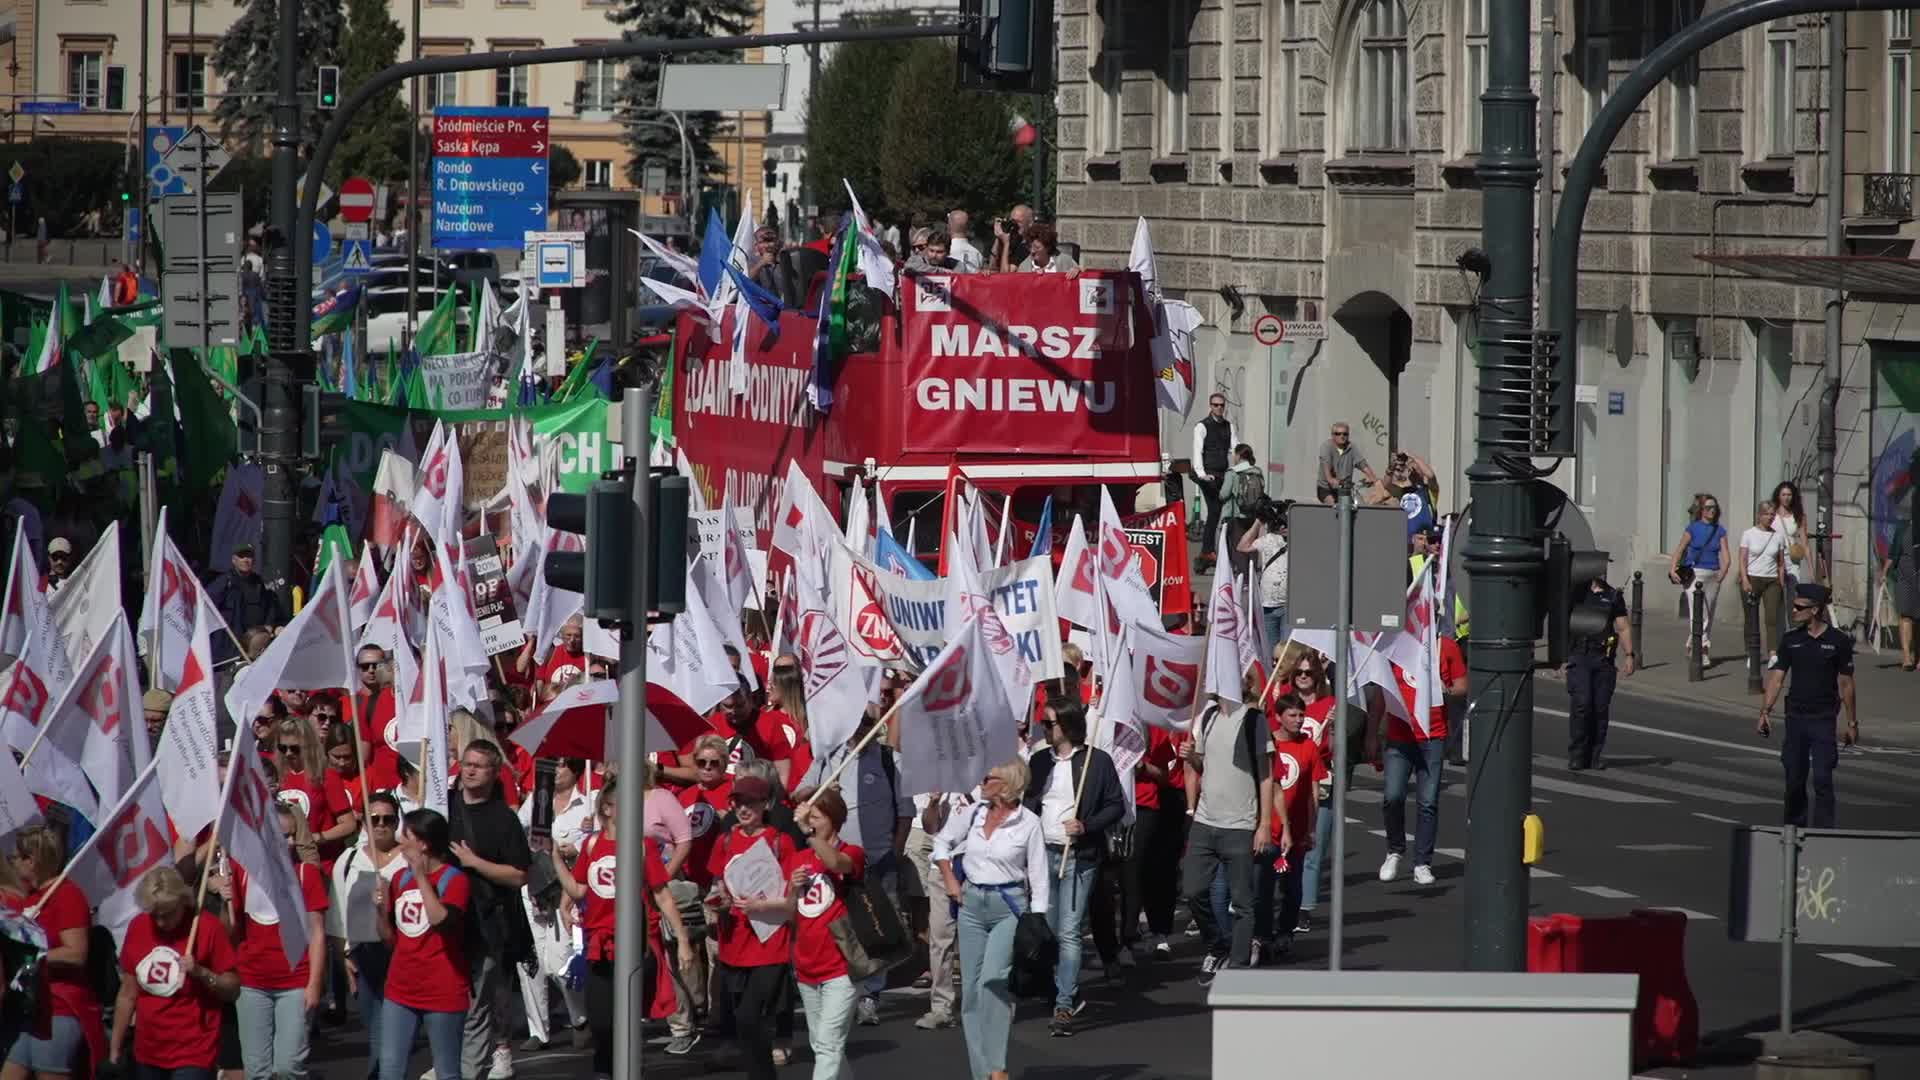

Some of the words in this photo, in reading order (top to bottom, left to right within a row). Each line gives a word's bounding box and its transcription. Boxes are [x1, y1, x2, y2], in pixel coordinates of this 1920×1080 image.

[437, 119, 505, 133] Śródmieście
[507, 120, 526, 133] Pn.
[437, 140, 469, 153] Saska
[471, 140, 500, 156] Kępa
[436, 161, 472, 174] Rondo
[436, 178, 447, 191] R.
[450, 178, 525, 195] Dmowskiego
[436, 201, 483, 215] Muzeum
[436, 219, 494, 233] Narodowe
[931, 324, 1103, 360] MARSZ
[917, 377, 1116, 413] GNIEWU
